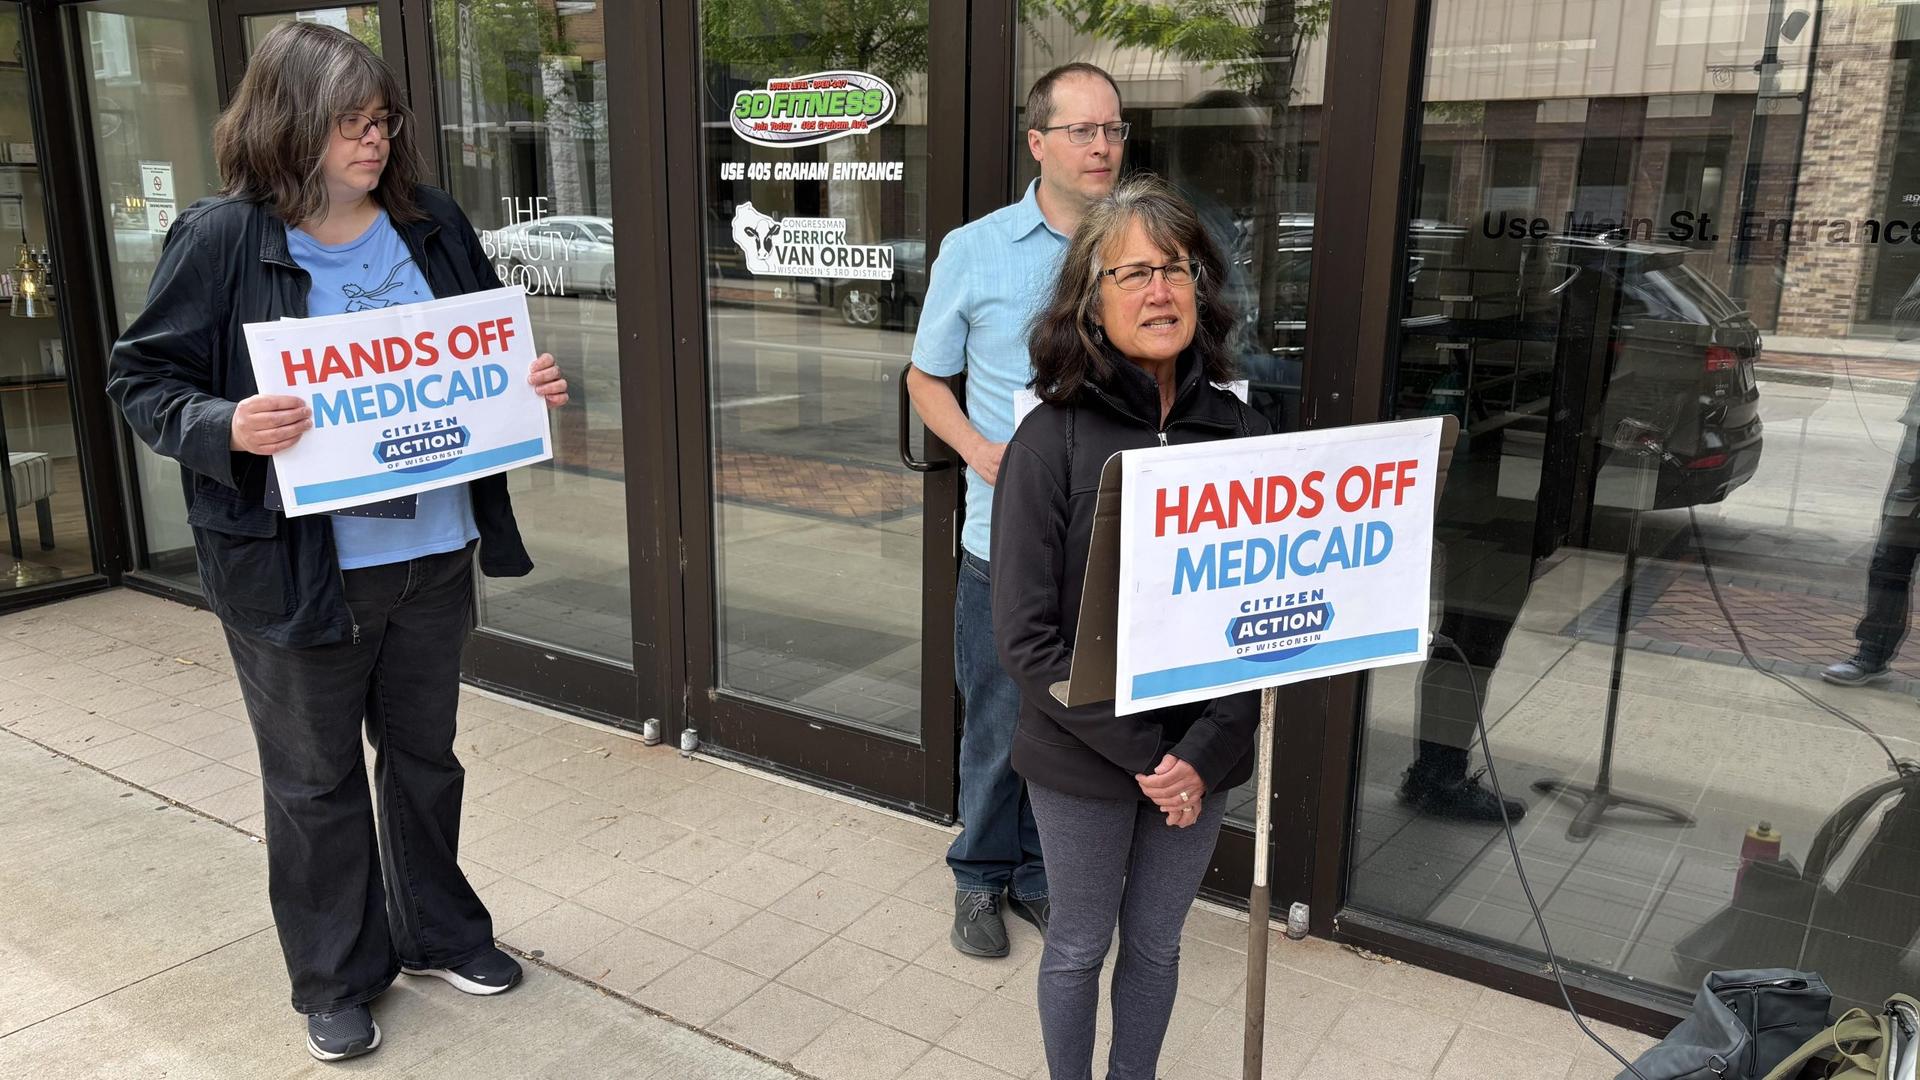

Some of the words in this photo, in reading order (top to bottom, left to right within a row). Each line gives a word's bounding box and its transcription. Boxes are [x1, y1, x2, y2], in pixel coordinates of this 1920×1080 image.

[735, 93, 771, 119] 3D
[771, 89, 883, 118] FITNESS
[752, 122, 769, 131] Join
[770, 122, 792, 132] Today
[801, 121, 815, 130] 405
[818, 120, 849, 130] Graham
[851, 119, 869, 130] Ave.
[720, 163, 745, 181] USE
[747, 162, 772, 181] 405
[774, 162, 829, 181] GRAHAM
[831, 162, 904, 181] ENTRANCE
[501, 196, 551, 226] THE
[783, 219, 845, 229] CONGRESSMAN
[783, 230, 844, 245] DERRICK
[1483, 210, 1550, 240] Use
[1668, 210, 1719, 242] St.
[482, 230, 574, 261] BEAUTY
[775, 246, 815, 266] VAN
[820, 247, 892, 269] ORDEN
[497, 264, 565, 296] ROOM
[777, 265, 830, 276] WISCONSIN'S
[834, 267, 849, 277] 3RD
[853, 268, 893, 278] DISTRICT
[281, 331, 439, 386] HANDS
[448, 317, 515, 360] OFF
[312, 363, 509, 428] MEDICAID
[382, 416, 458, 439] CITIZEN
[386, 431, 462, 458] ACTION
[405, 449, 463, 466] WISCONSIN
[1155, 471, 1325, 537] HANDS
[1336, 459, 1418, 513] OFF
[1172, 521, 1393, 596] MEDICAID
[1240, 588, 1324, 613] CITIZEN
[1238, 610, 1323, 639] ACTION
[1236, 646, 1251, 655] OF
[1256, 634, 1322, 652] WISCONSIN
